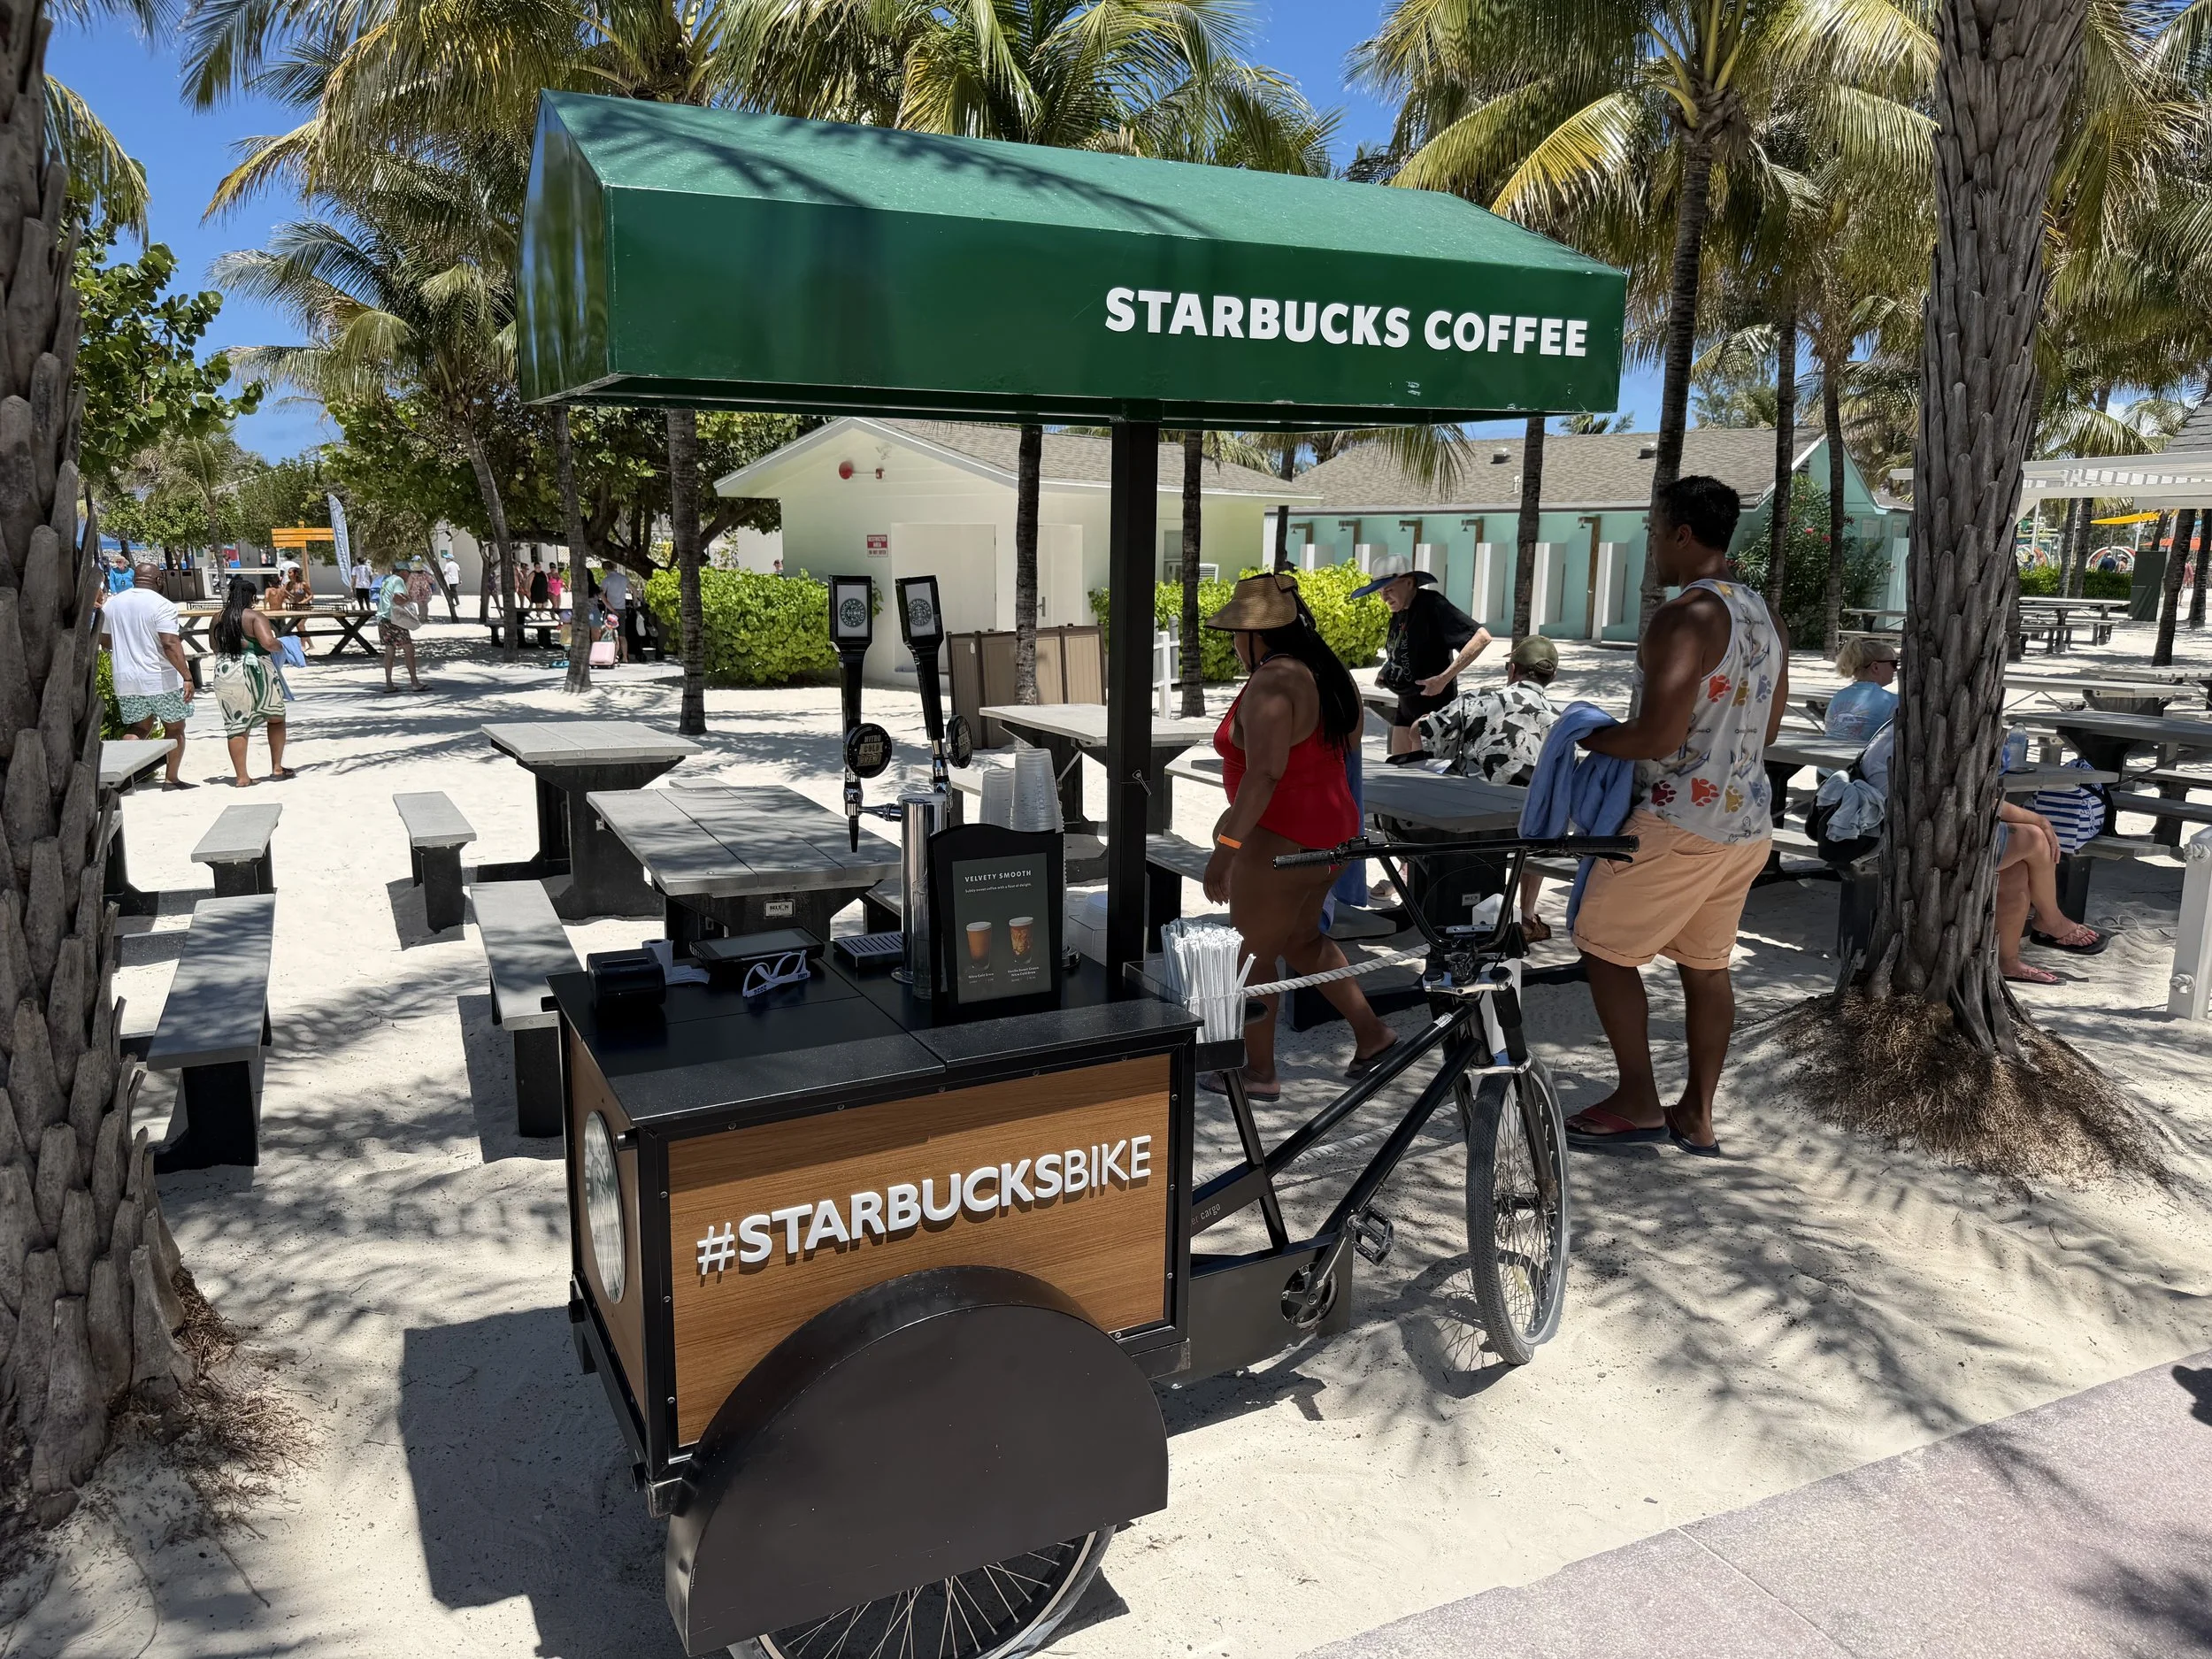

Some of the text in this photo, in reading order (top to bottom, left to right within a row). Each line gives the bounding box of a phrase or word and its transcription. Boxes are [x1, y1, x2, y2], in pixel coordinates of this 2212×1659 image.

[1105, 287, 1588, 357] STARBUCKS COFFEE
[1401, 651, 1411, 682] COSTA
[864, 734, 881, 743] NITRO
[964, 870, 1032, 883] VELVETY SMOOTH
[696, 1135, 1152, 1275] #STARBUCKSBIKE
[1200, 1203, 1221, 1220] cargo
